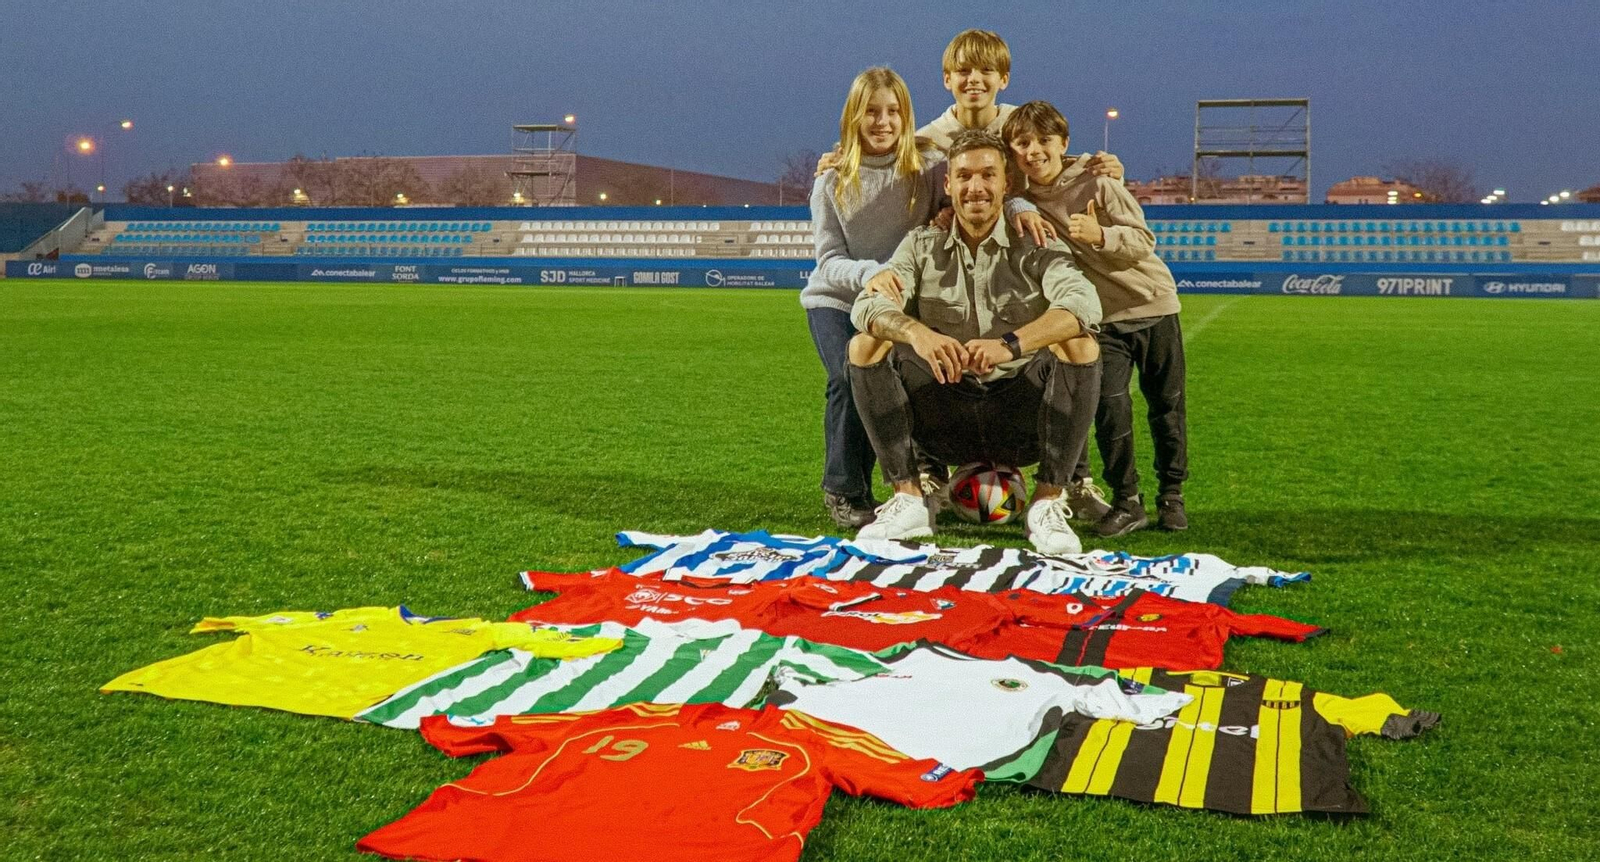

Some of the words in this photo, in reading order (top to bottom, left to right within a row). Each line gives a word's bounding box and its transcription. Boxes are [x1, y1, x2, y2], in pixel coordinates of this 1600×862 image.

[187, 263, 217, 274] AGON
[325, 269, 376, 277] conectabalear
[395, 265, 416, 273] FONT
[438, 276, 522, 284] www.grupofleming.com
[540, 270, 566, 283] SJD
[633, 271, 660, 284] GOMILA
[660, 271, 680, 284] GOST
[1195, 279, 1262, 289] conectabalear
[1377, 278, 1453, 295] 971PRINT
[1508, 283, 1566, 293] HYUNDAI
[581, 735, 649, 762] 19
